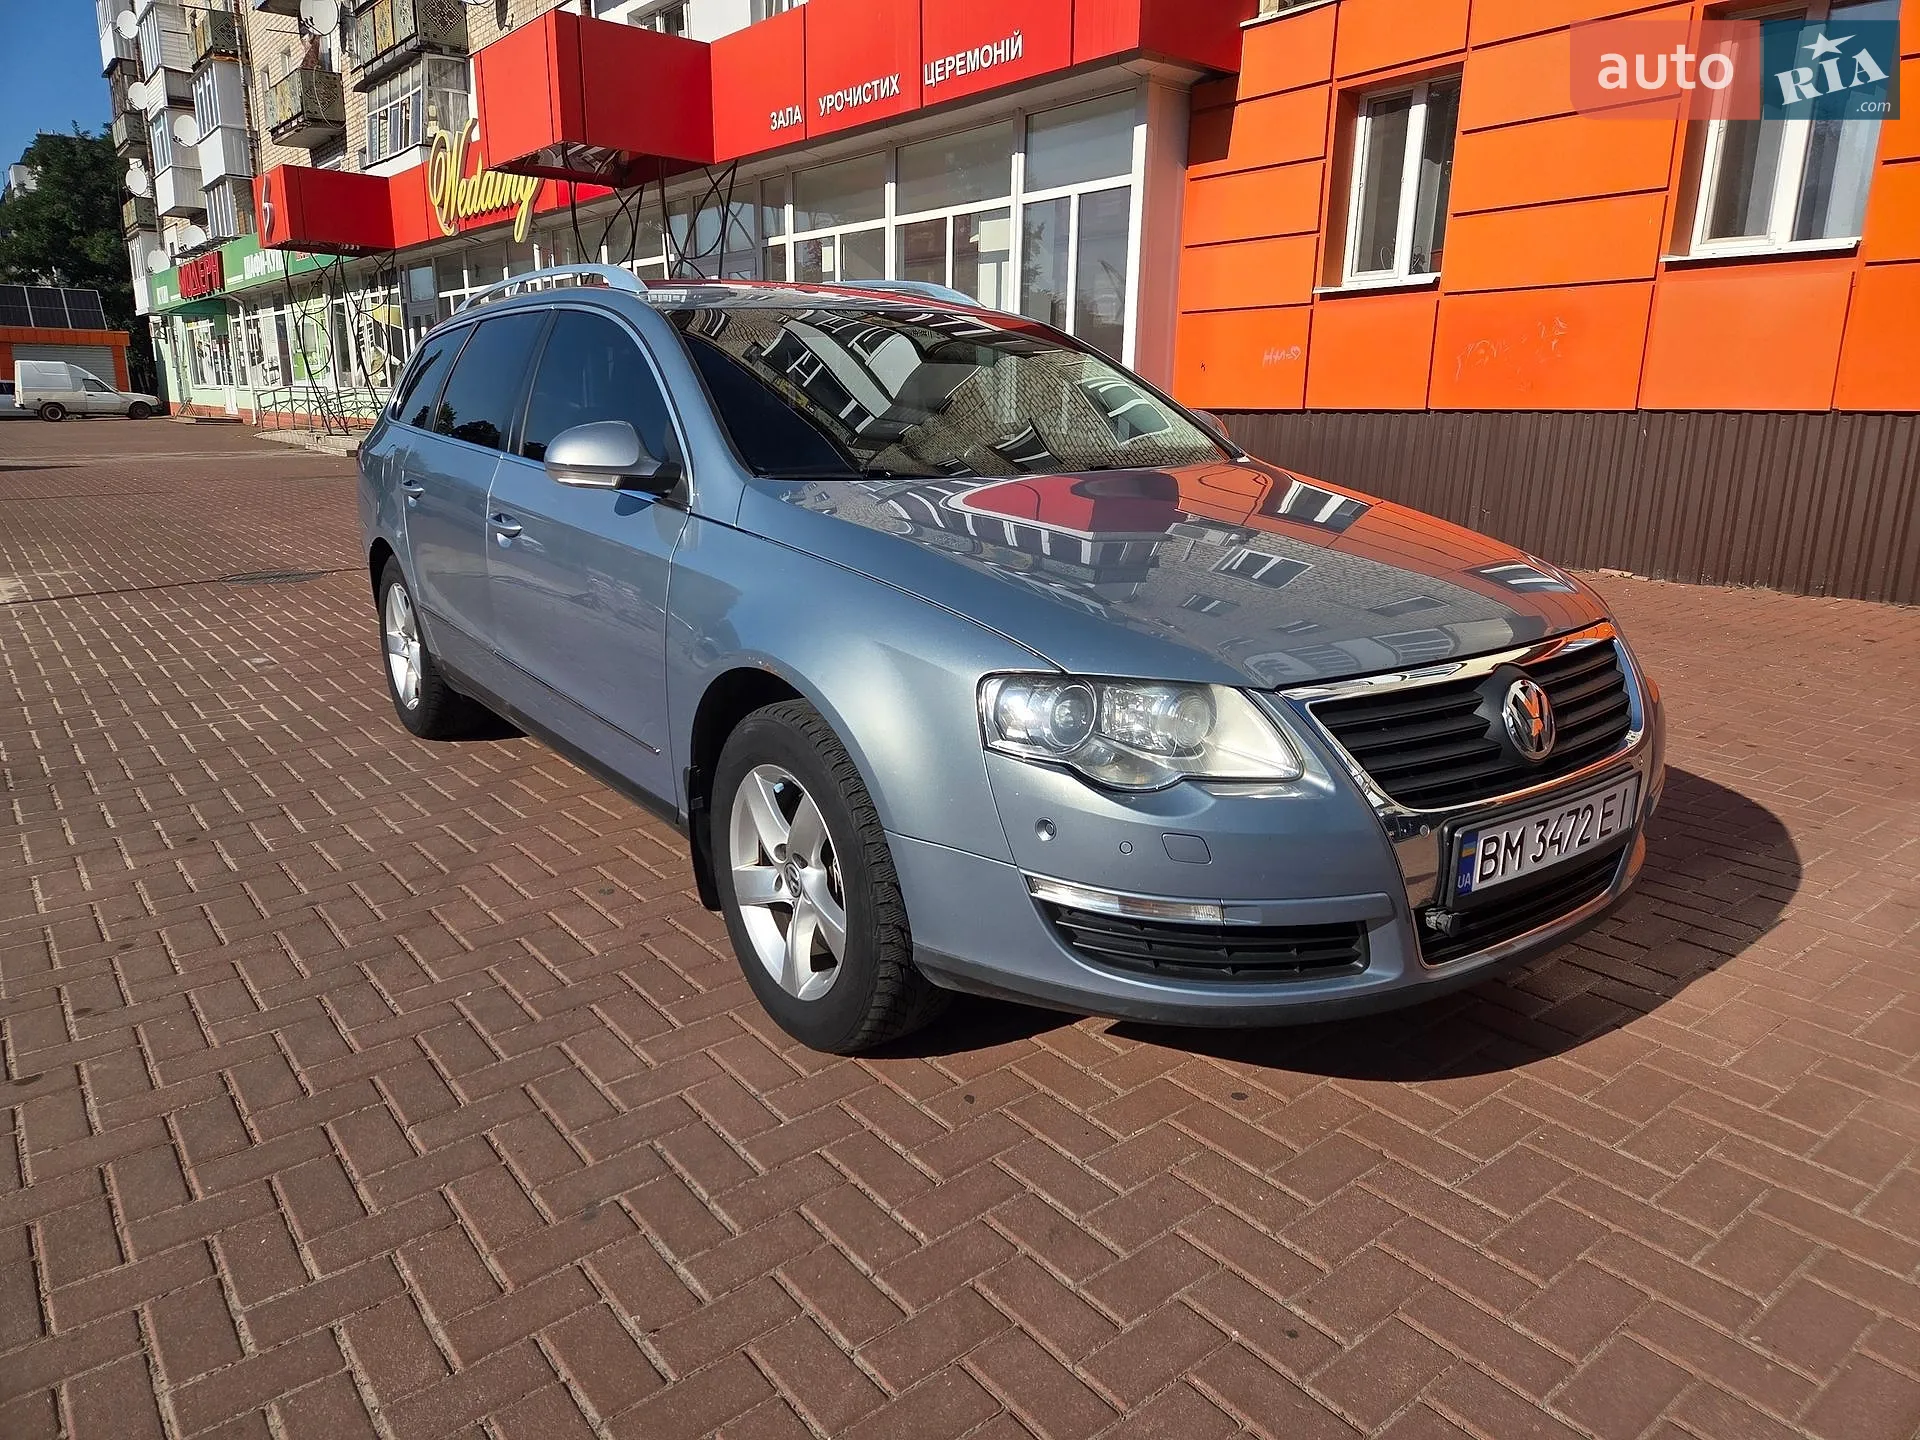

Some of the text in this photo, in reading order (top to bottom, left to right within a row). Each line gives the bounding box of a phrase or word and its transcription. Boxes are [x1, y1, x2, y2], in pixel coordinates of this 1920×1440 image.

[769, 30, 1024, 131] ЗАЛА УРОЧИСТИХ ЦЕРЕМОНІЙ
[1457, 874, 1472, 889] UA
[1476, 826, 1525, 884] BM
[1530, 803, 1594, 863] 3472
